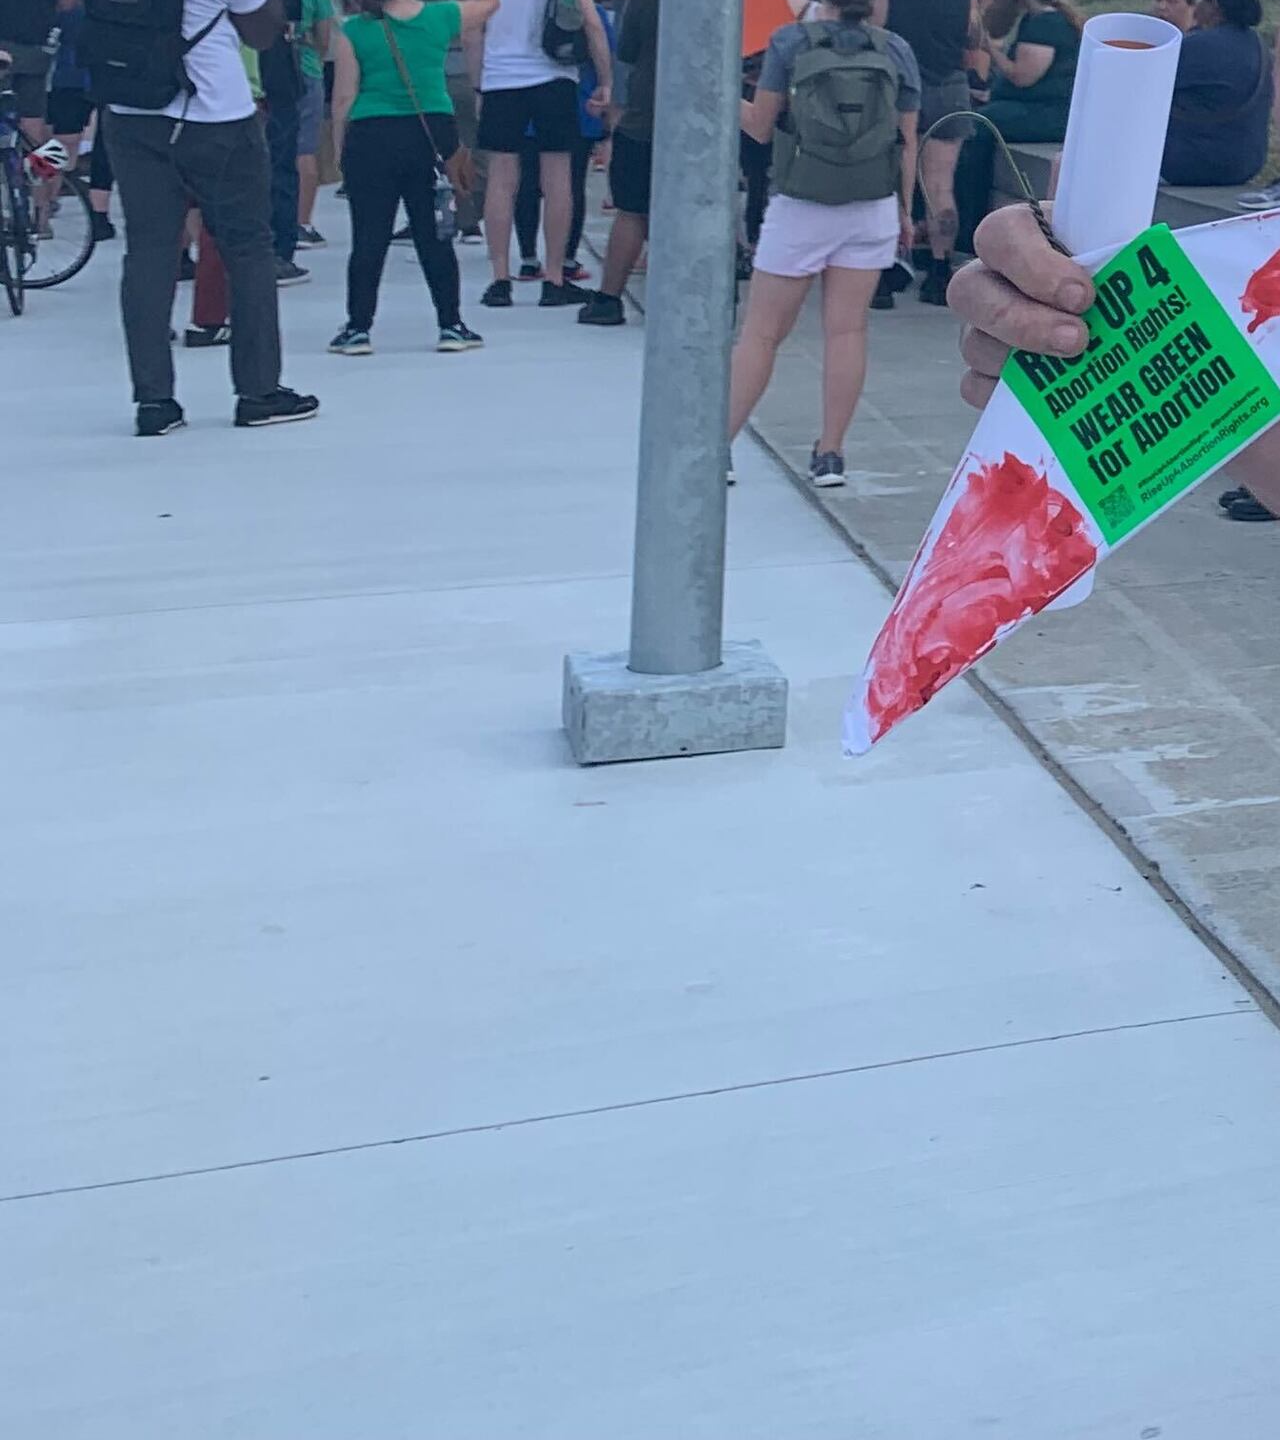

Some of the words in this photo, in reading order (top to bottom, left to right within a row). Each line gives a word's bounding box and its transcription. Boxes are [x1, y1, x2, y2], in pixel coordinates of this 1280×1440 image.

[1043, 341, 1131, 420] Abortion
[1124, 284, 1192, 355] Rights!
[1095, 270, 1138, 331] UP
[1136, 244, 1172, 291] 4
[1069, 378, 1145, 452] WEAR
[1138, 320, 1212, 398] GREEN
[1086, 438, 1133, 487] for
[1131, 353, 1236, 456] Abortion
[1140, 396, 1271, 504] RiseUp4AbortionRights.org
